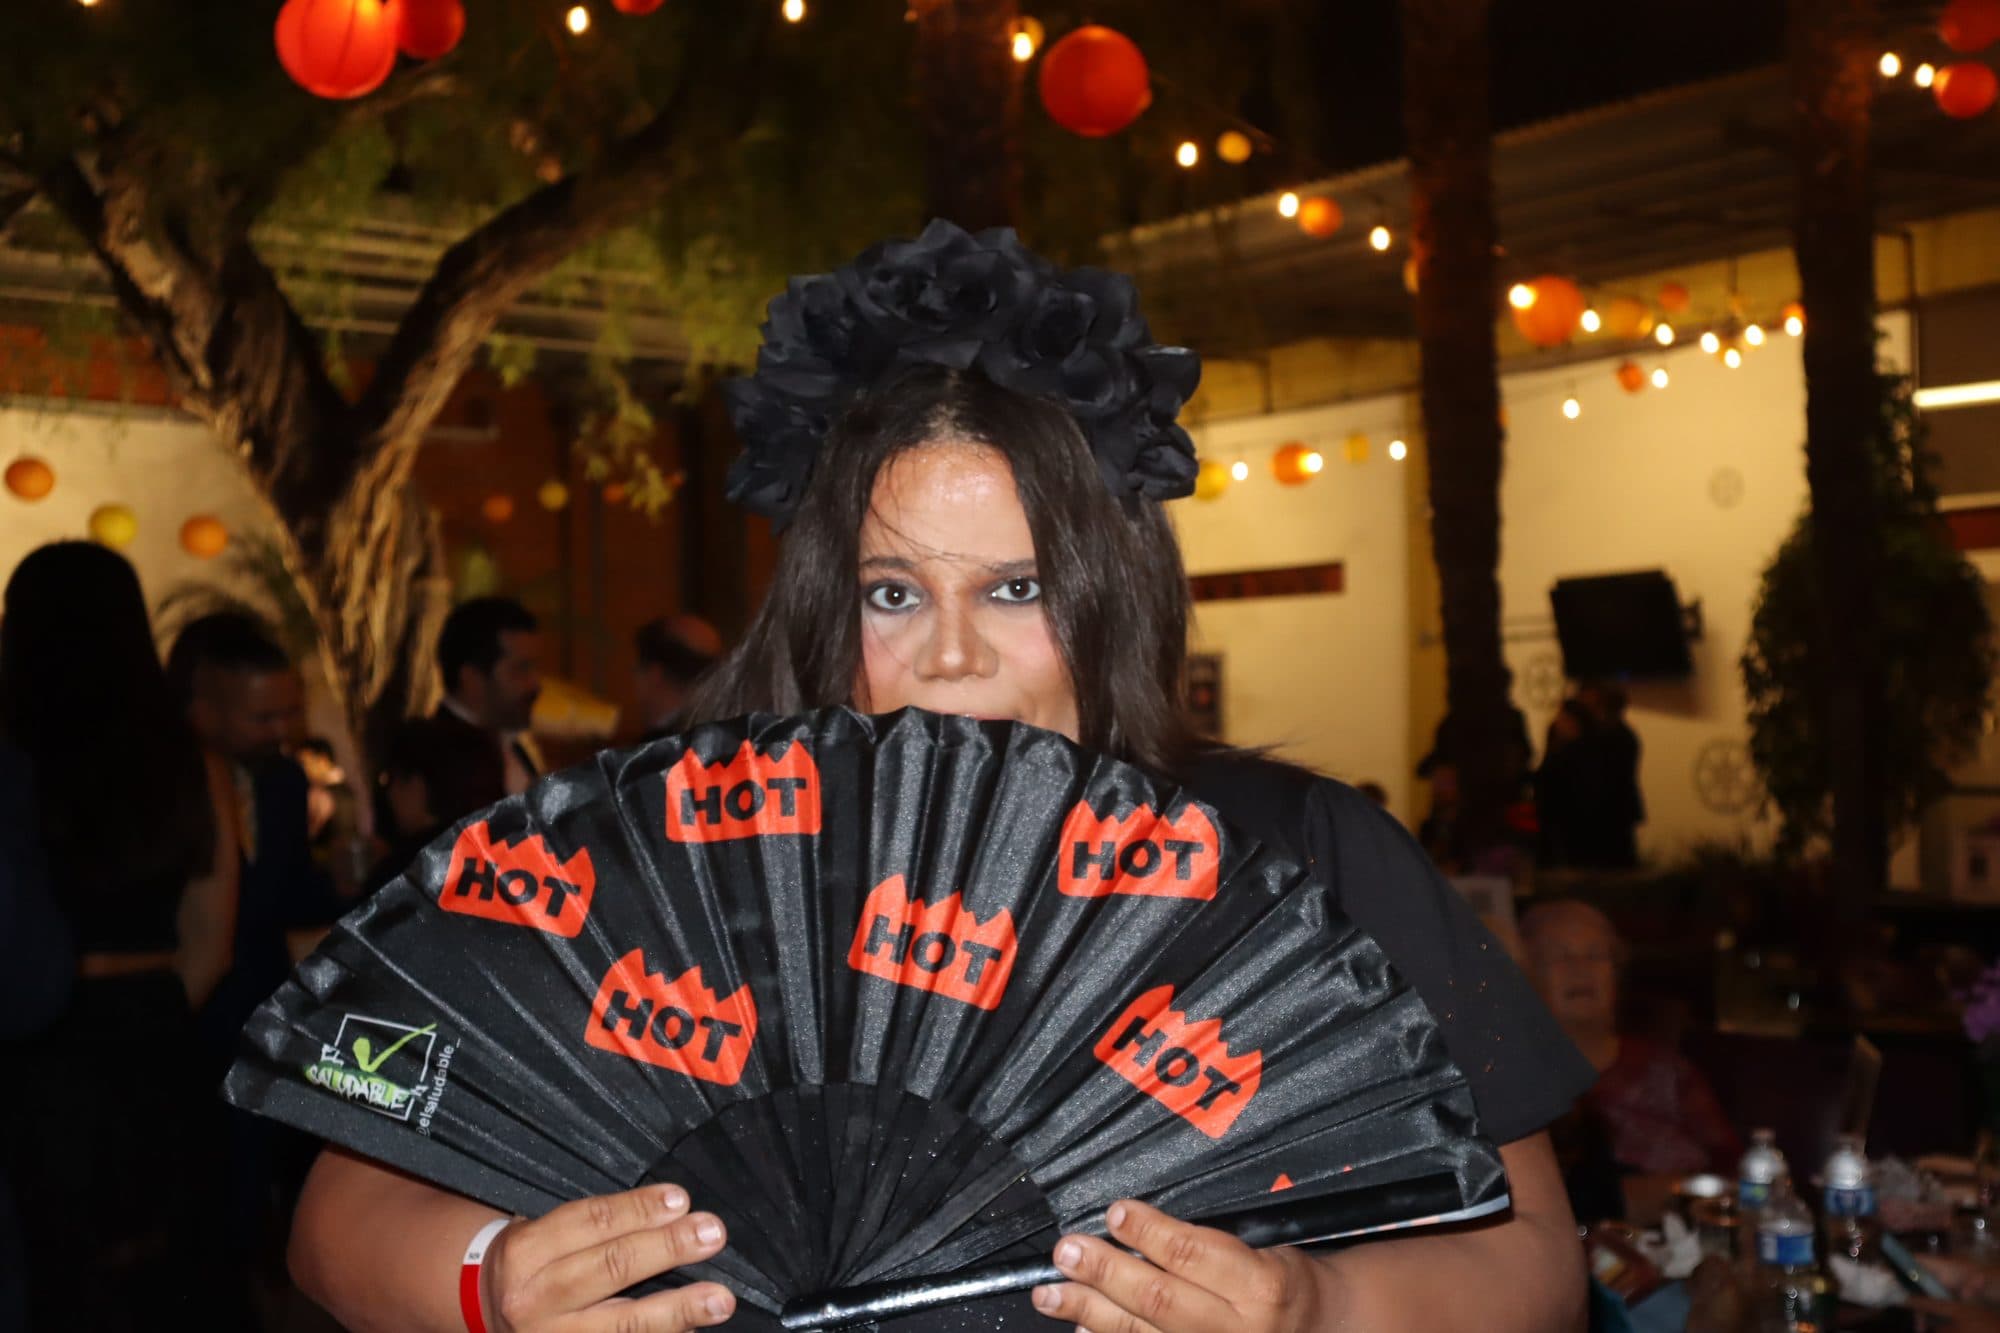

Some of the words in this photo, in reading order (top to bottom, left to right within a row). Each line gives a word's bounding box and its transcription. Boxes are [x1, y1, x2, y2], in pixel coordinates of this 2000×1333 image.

[681, 777, 806, 825] HOT
[454, 857, 581, 918] HOT
[1072, 839, 1204, 880] HOT
[864, 914, 1002, 985] HOT
[601, 989, 742, 1063] HOT
[1112, 1016, 1241, 1111] HOT
